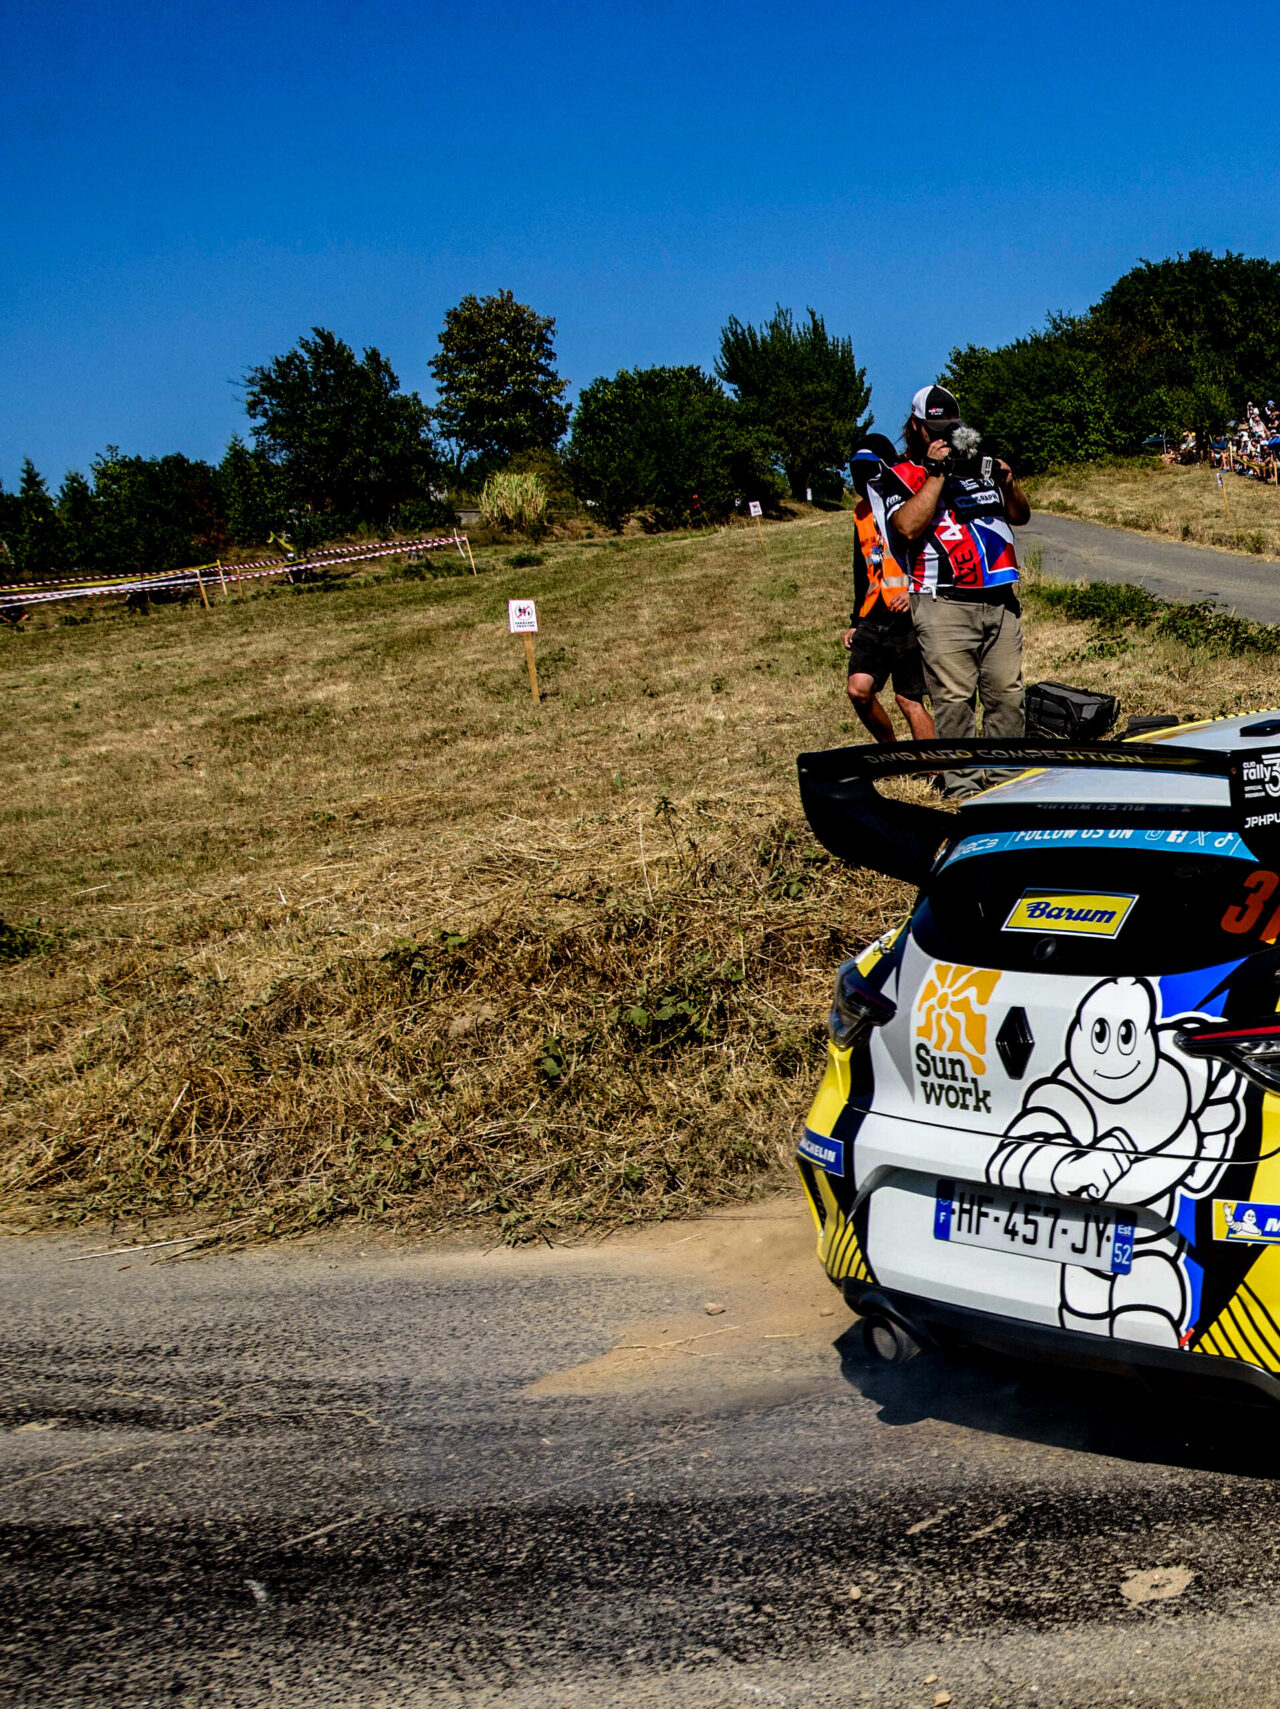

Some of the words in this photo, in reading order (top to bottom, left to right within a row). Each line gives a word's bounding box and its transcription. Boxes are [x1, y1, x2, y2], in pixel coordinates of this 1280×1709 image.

[863, 751, 916, 764] DAVID
[919, 749, 972, 760] AUTO
[976, 750, 1145, 764] COMPETITION
[1243, 763, 1272, 782] rally
[1026, 901, 1117, 924] Barum
[915, 1042, 969, 1083] Sun
[920, 1077, 992, 1114] work
[939, 1212, 947, 1224] F
[1117, 1224, 1133, 1236] Est
[1113, 1242, 1132, 1265] 52
